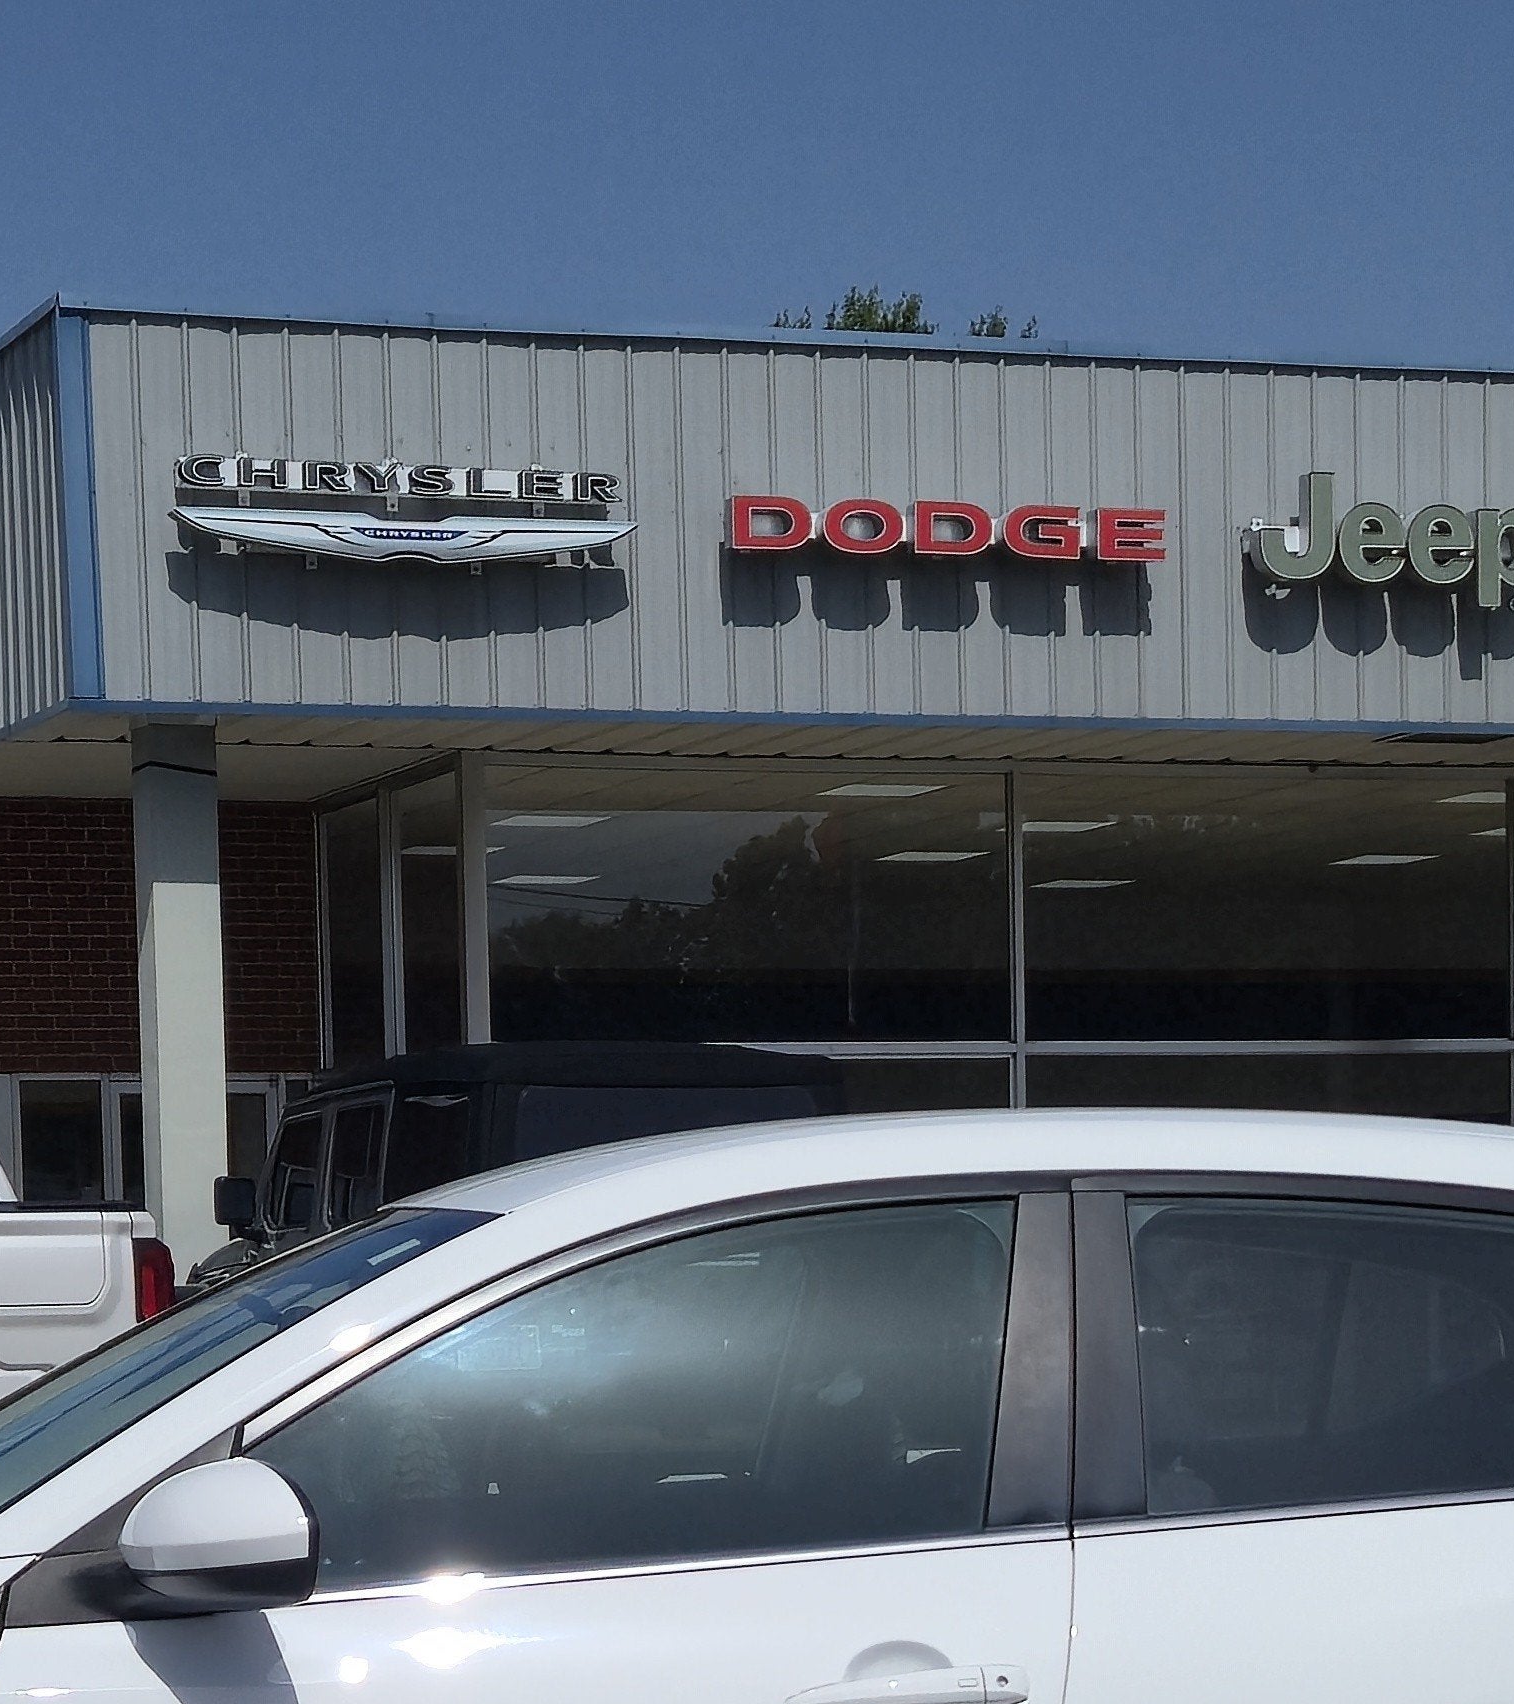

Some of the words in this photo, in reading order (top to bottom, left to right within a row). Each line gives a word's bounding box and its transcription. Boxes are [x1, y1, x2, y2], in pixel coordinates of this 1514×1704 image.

[177, 453, 623, 502] CHRYSLER
[364, 529, 453, 539] CHRYSLER
[724, 494, 1166, 562] DODGE
